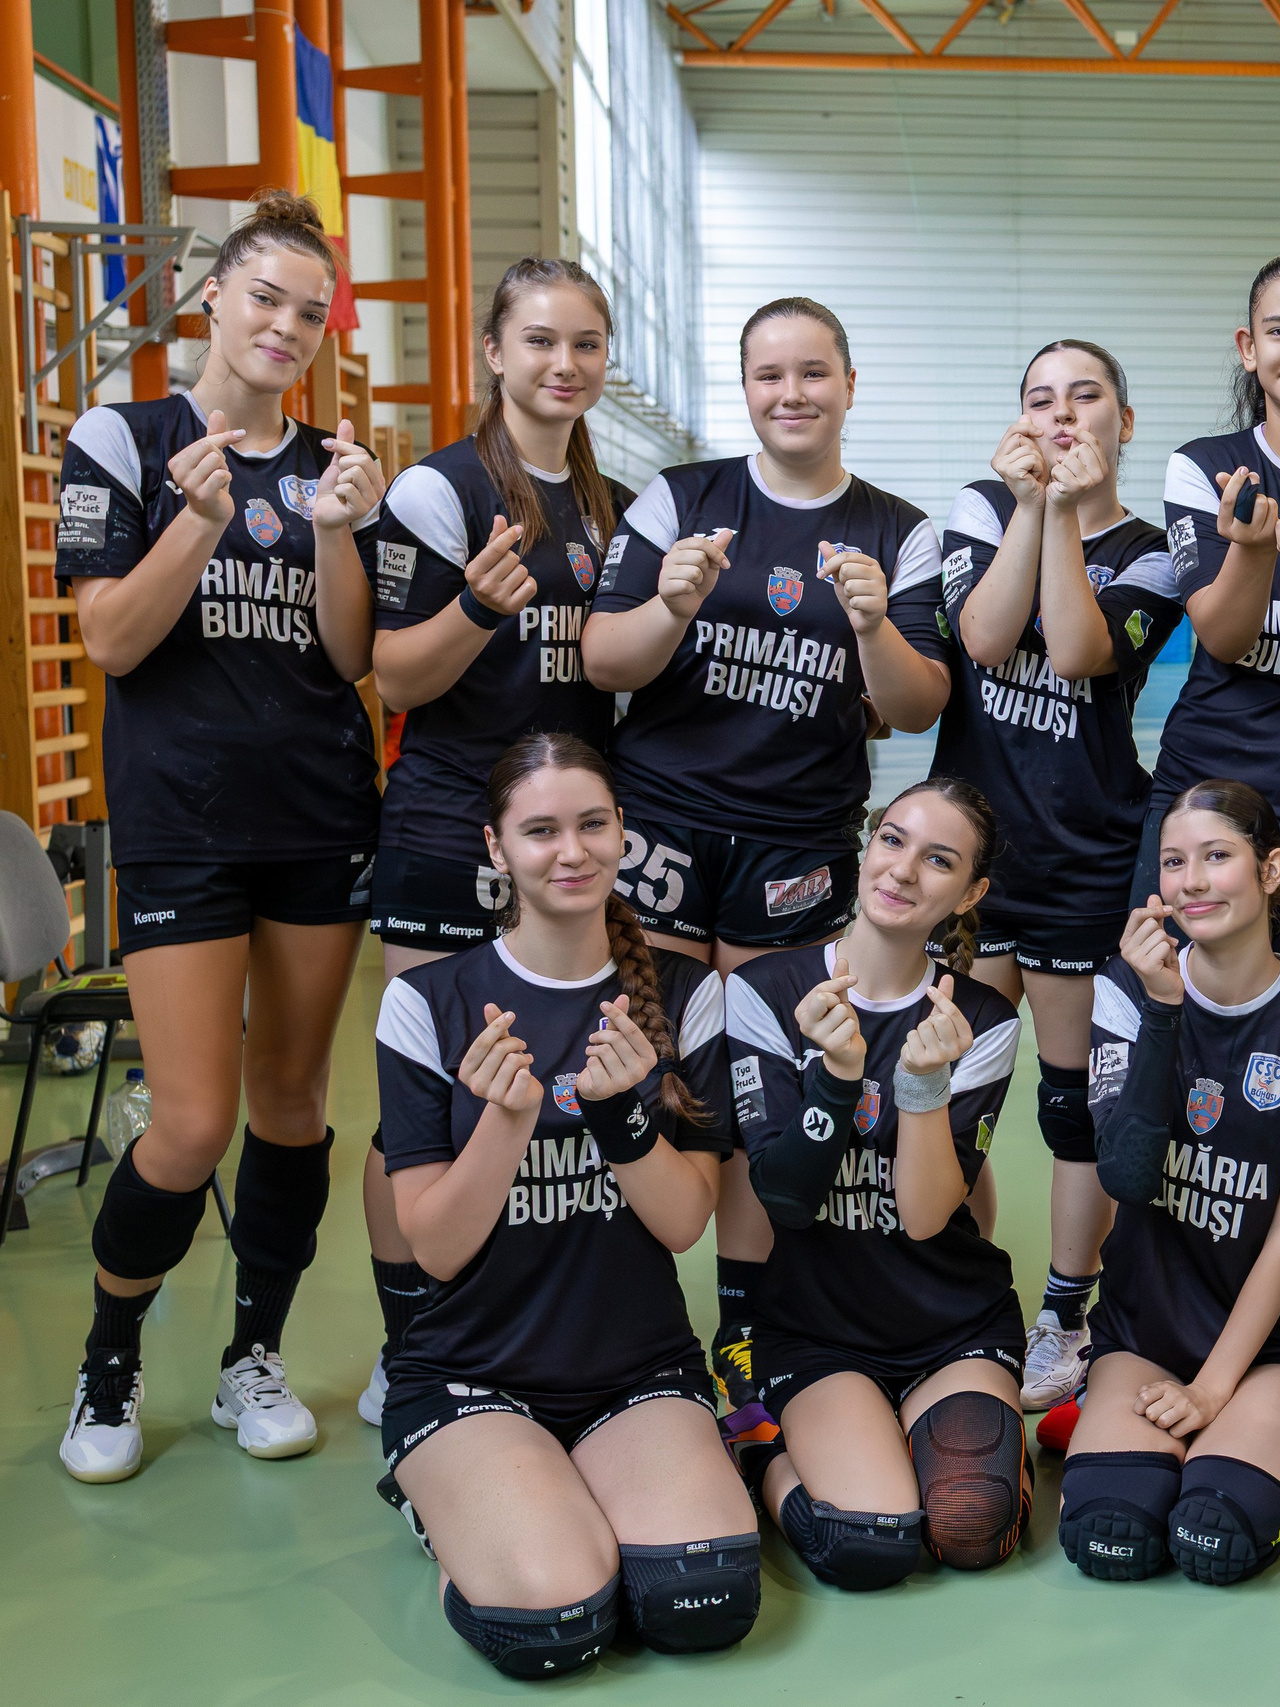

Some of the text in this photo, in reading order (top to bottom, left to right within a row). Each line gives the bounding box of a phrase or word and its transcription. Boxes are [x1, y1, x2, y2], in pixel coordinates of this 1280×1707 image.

[75, 490, 97, 502] Tya
[68, 502, 101, 514] Fruct
[610, 541, 620, 551] ya
[387, 548, 406, 561] Tya
[948, 554, 963, 567] Tya
[382, 560, 407, 573] Fruct
[947, 560, 968, 579] Fruct
[201, 556, 316, 608] RIMĂRI
[202, 601, 317, 653] BUHUȘ
[695, 620, 847, 683] PRIMĂRIA
[704, 661, 824, 722] BUHUȘI
[133, 908, 176, 925] Kempa
[632, 913, 658, 925] mpa
[387, 916, 426, 933] Kempa
[439, 922, 483, 938] Kempa
[1016, 952, 1093, 972] Kempa Kempa
[735, 1065, 751, 1077] Tya
[735, 1075, 757, 1091] Fruct
[1162, 1140, 1268, 1200] MĂRIA
[508, 1171, 629, 1226] BUHUȘ
[628, 1390, 682, 1406] Kempa
[403, 1419, 439, 1449] Kempa
[457, 1404, 514, 1416] Kempa
[876, 1516, 899, 1525] SELECT
[1177, 1526, 1221, 1549] SELECT
[686, 1542, 710, 1552] SELECT
[1088, 1541, 1134, 1557] SELECT
[560, 1605, 585, 1620] SELECT
